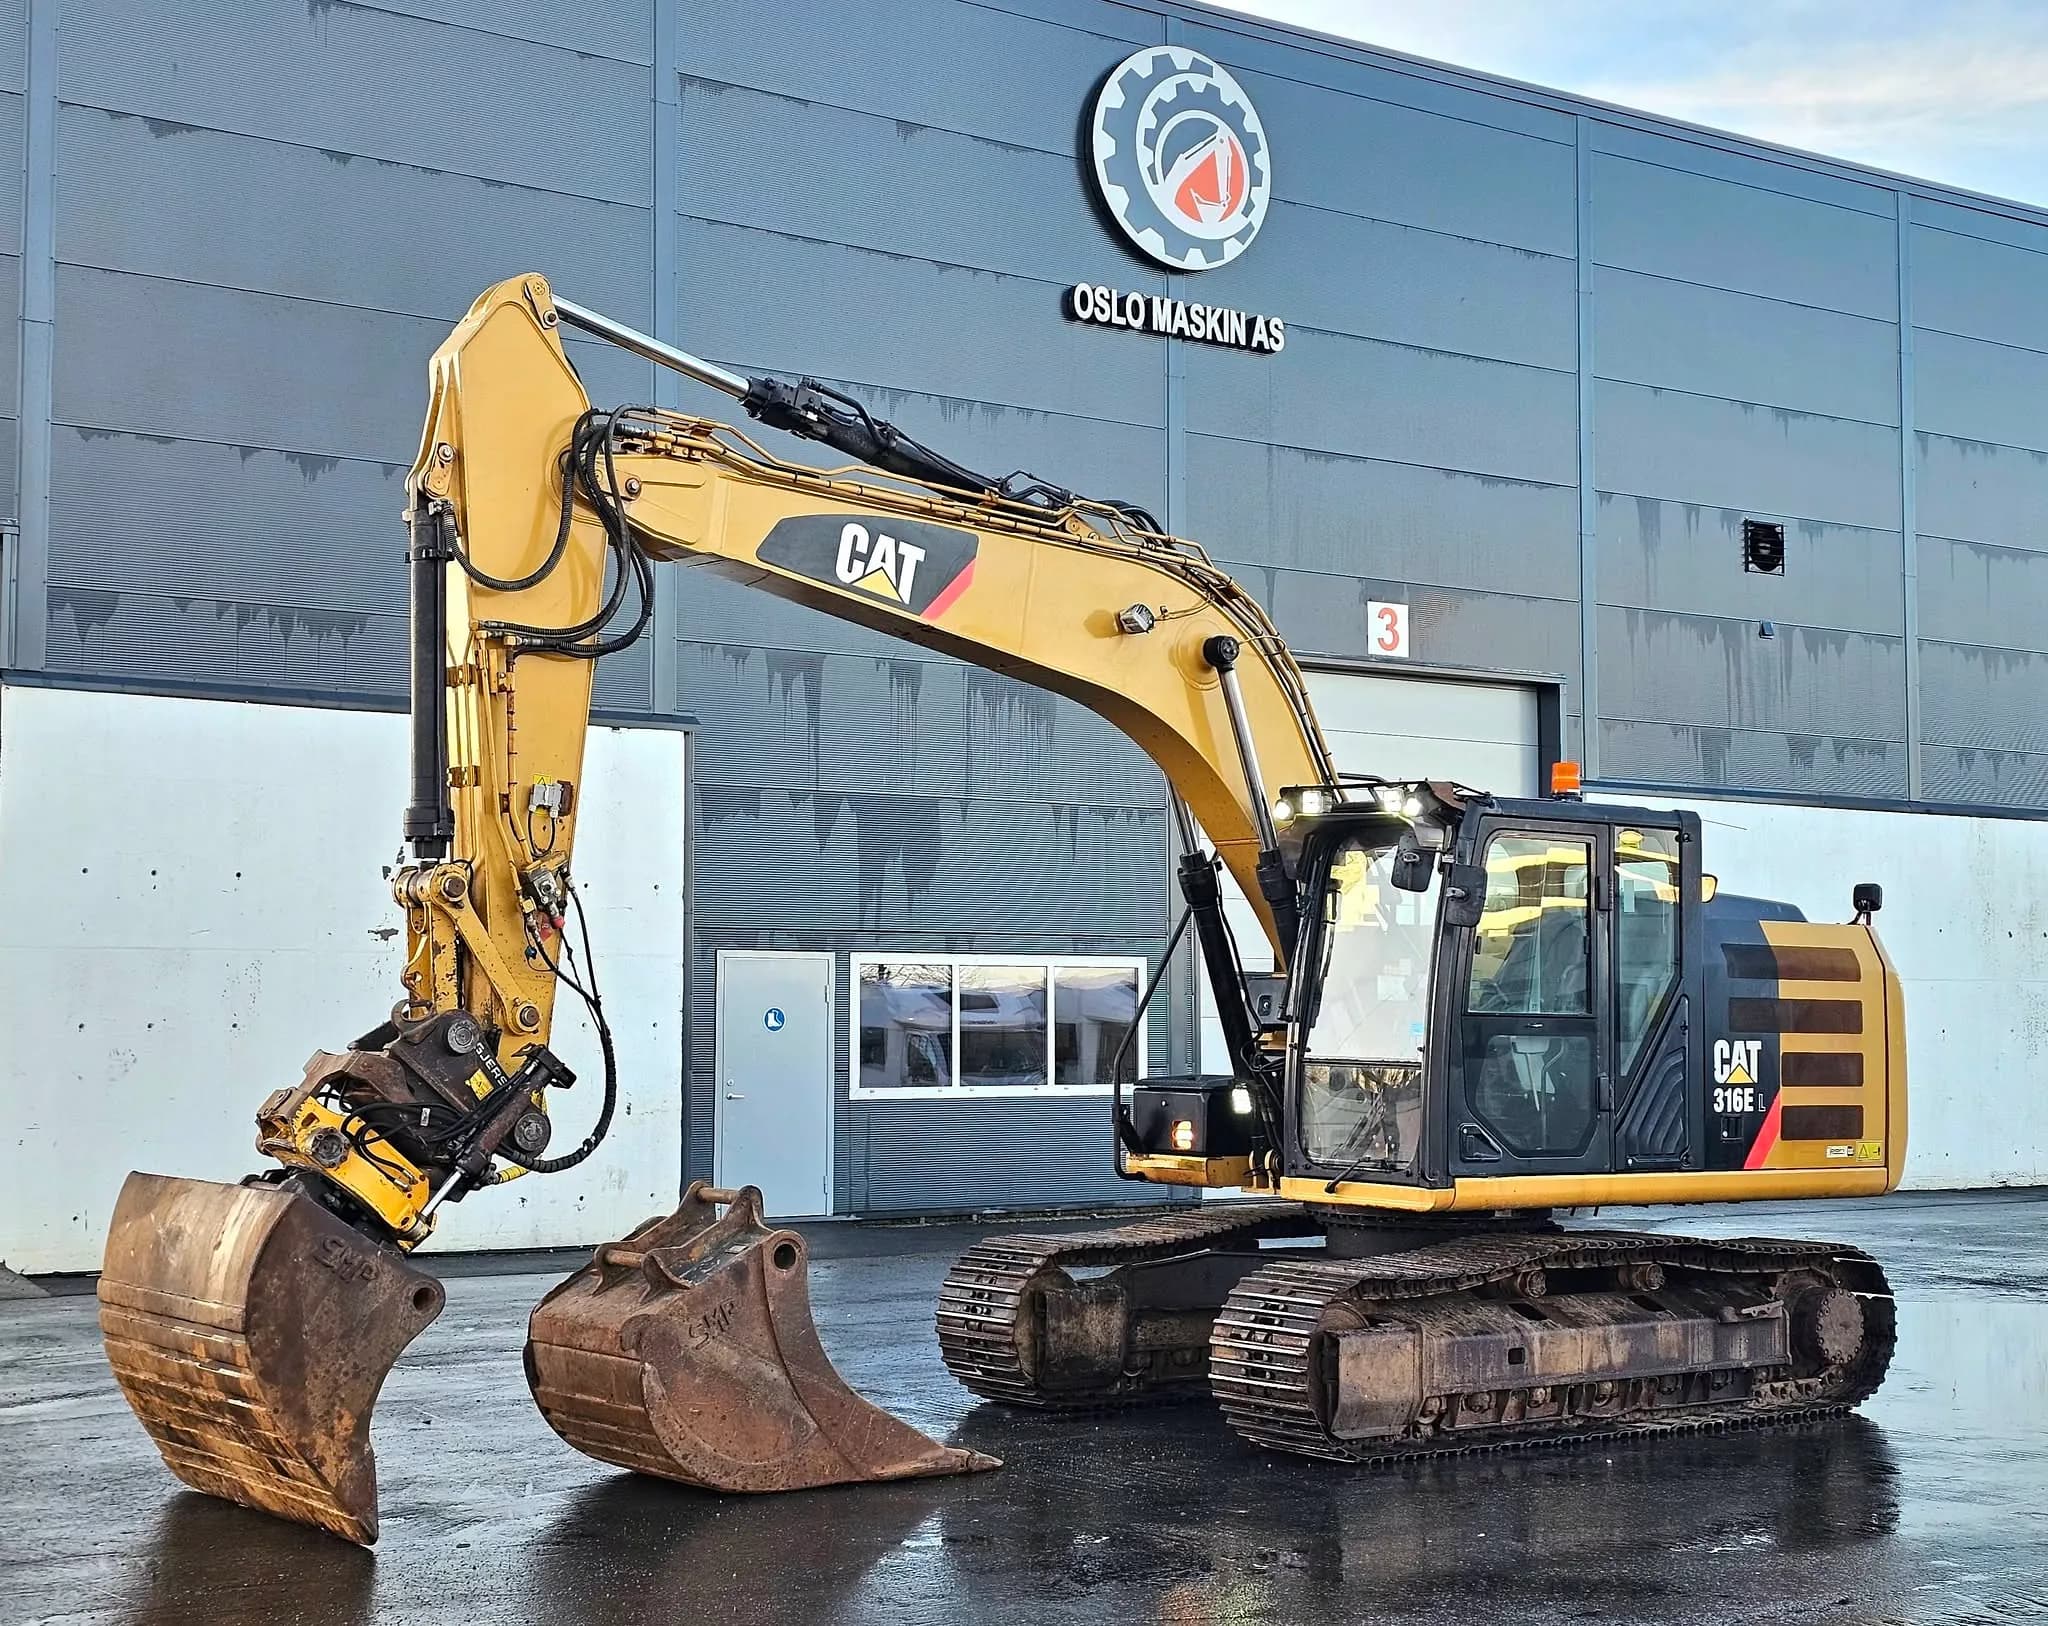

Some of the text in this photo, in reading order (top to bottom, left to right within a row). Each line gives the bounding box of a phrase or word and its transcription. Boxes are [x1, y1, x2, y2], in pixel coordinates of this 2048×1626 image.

[1074, 283, 1285, 352] OSLO MASKIN AS
[835, 522, 926, 604] CAT
[1377, 607, 1400, 651] 3
[475, 1042, 511, 1091] GJERS
[1713, 1039, 1762, 1084] CAT
[1713, 1087, 1766, 1113] 316E L
